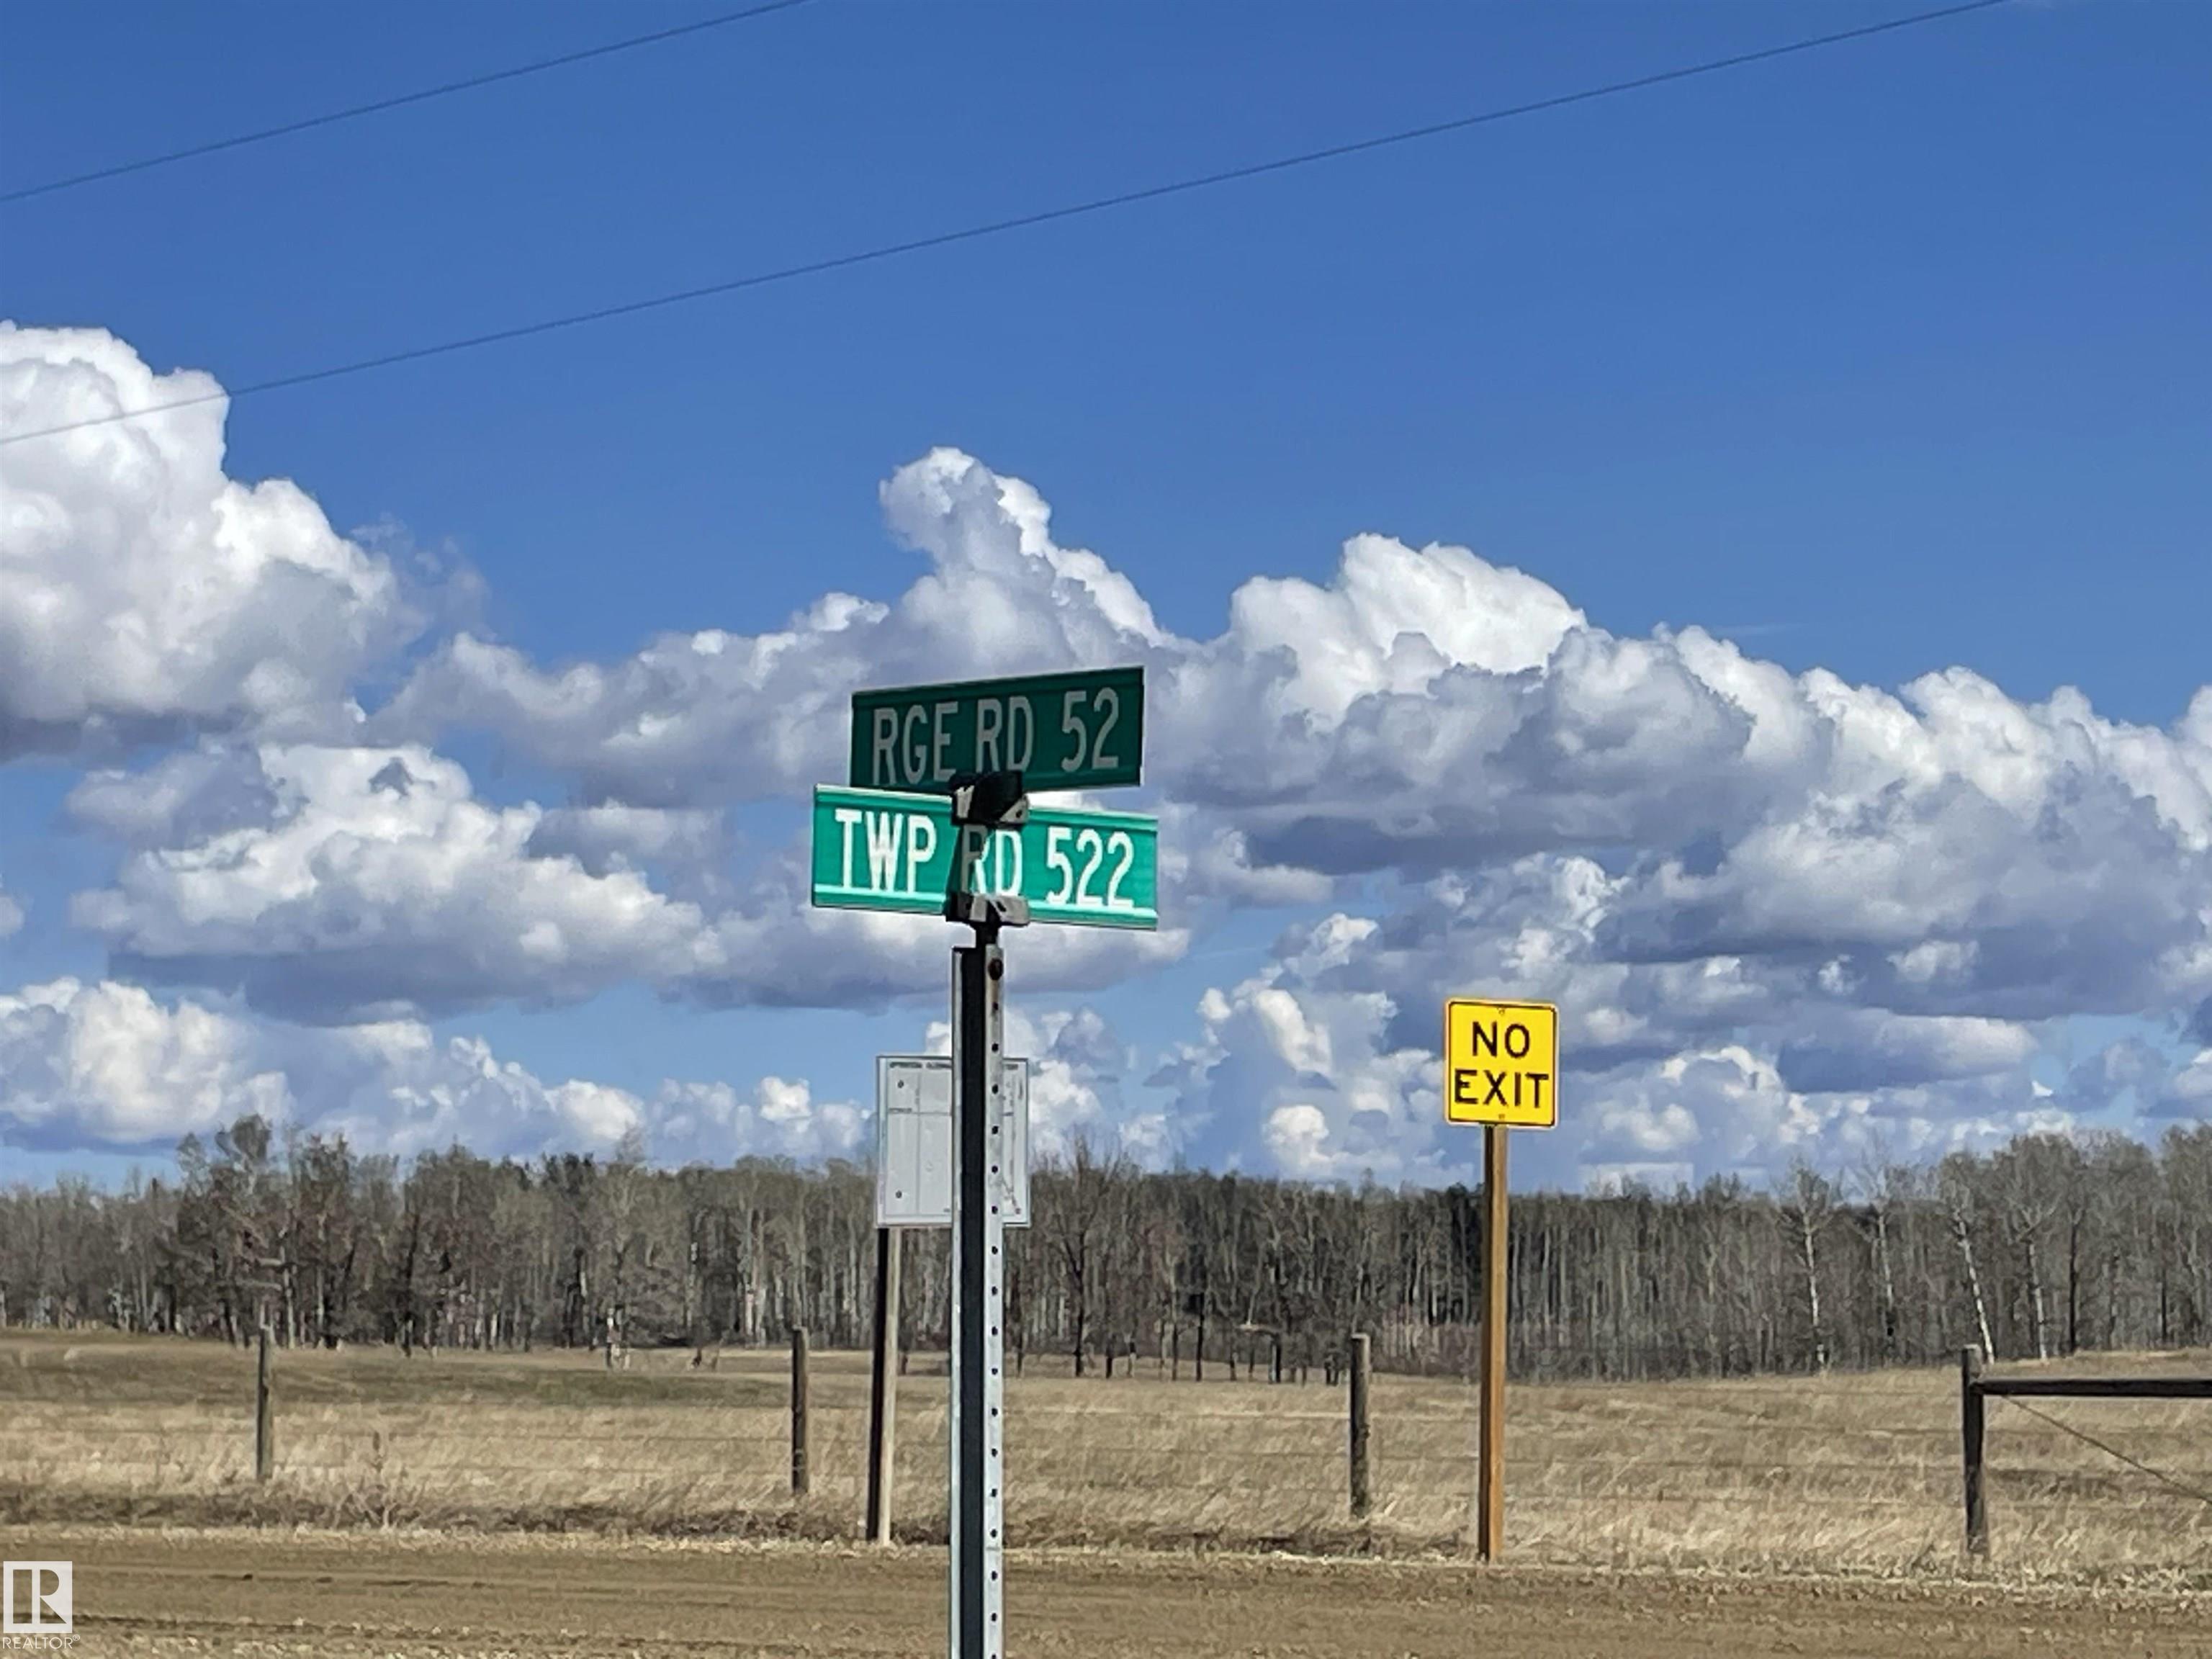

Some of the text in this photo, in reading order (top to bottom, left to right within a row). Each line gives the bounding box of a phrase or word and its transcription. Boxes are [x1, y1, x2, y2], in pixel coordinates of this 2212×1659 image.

[873, 688, 1120, 786] RGE RD 52
[835, 809, 1135, 909] TWP RD 522
[1473, 1021, 1530, 1058] NO
[1455, 1069, 1549, 1108] EXIT
